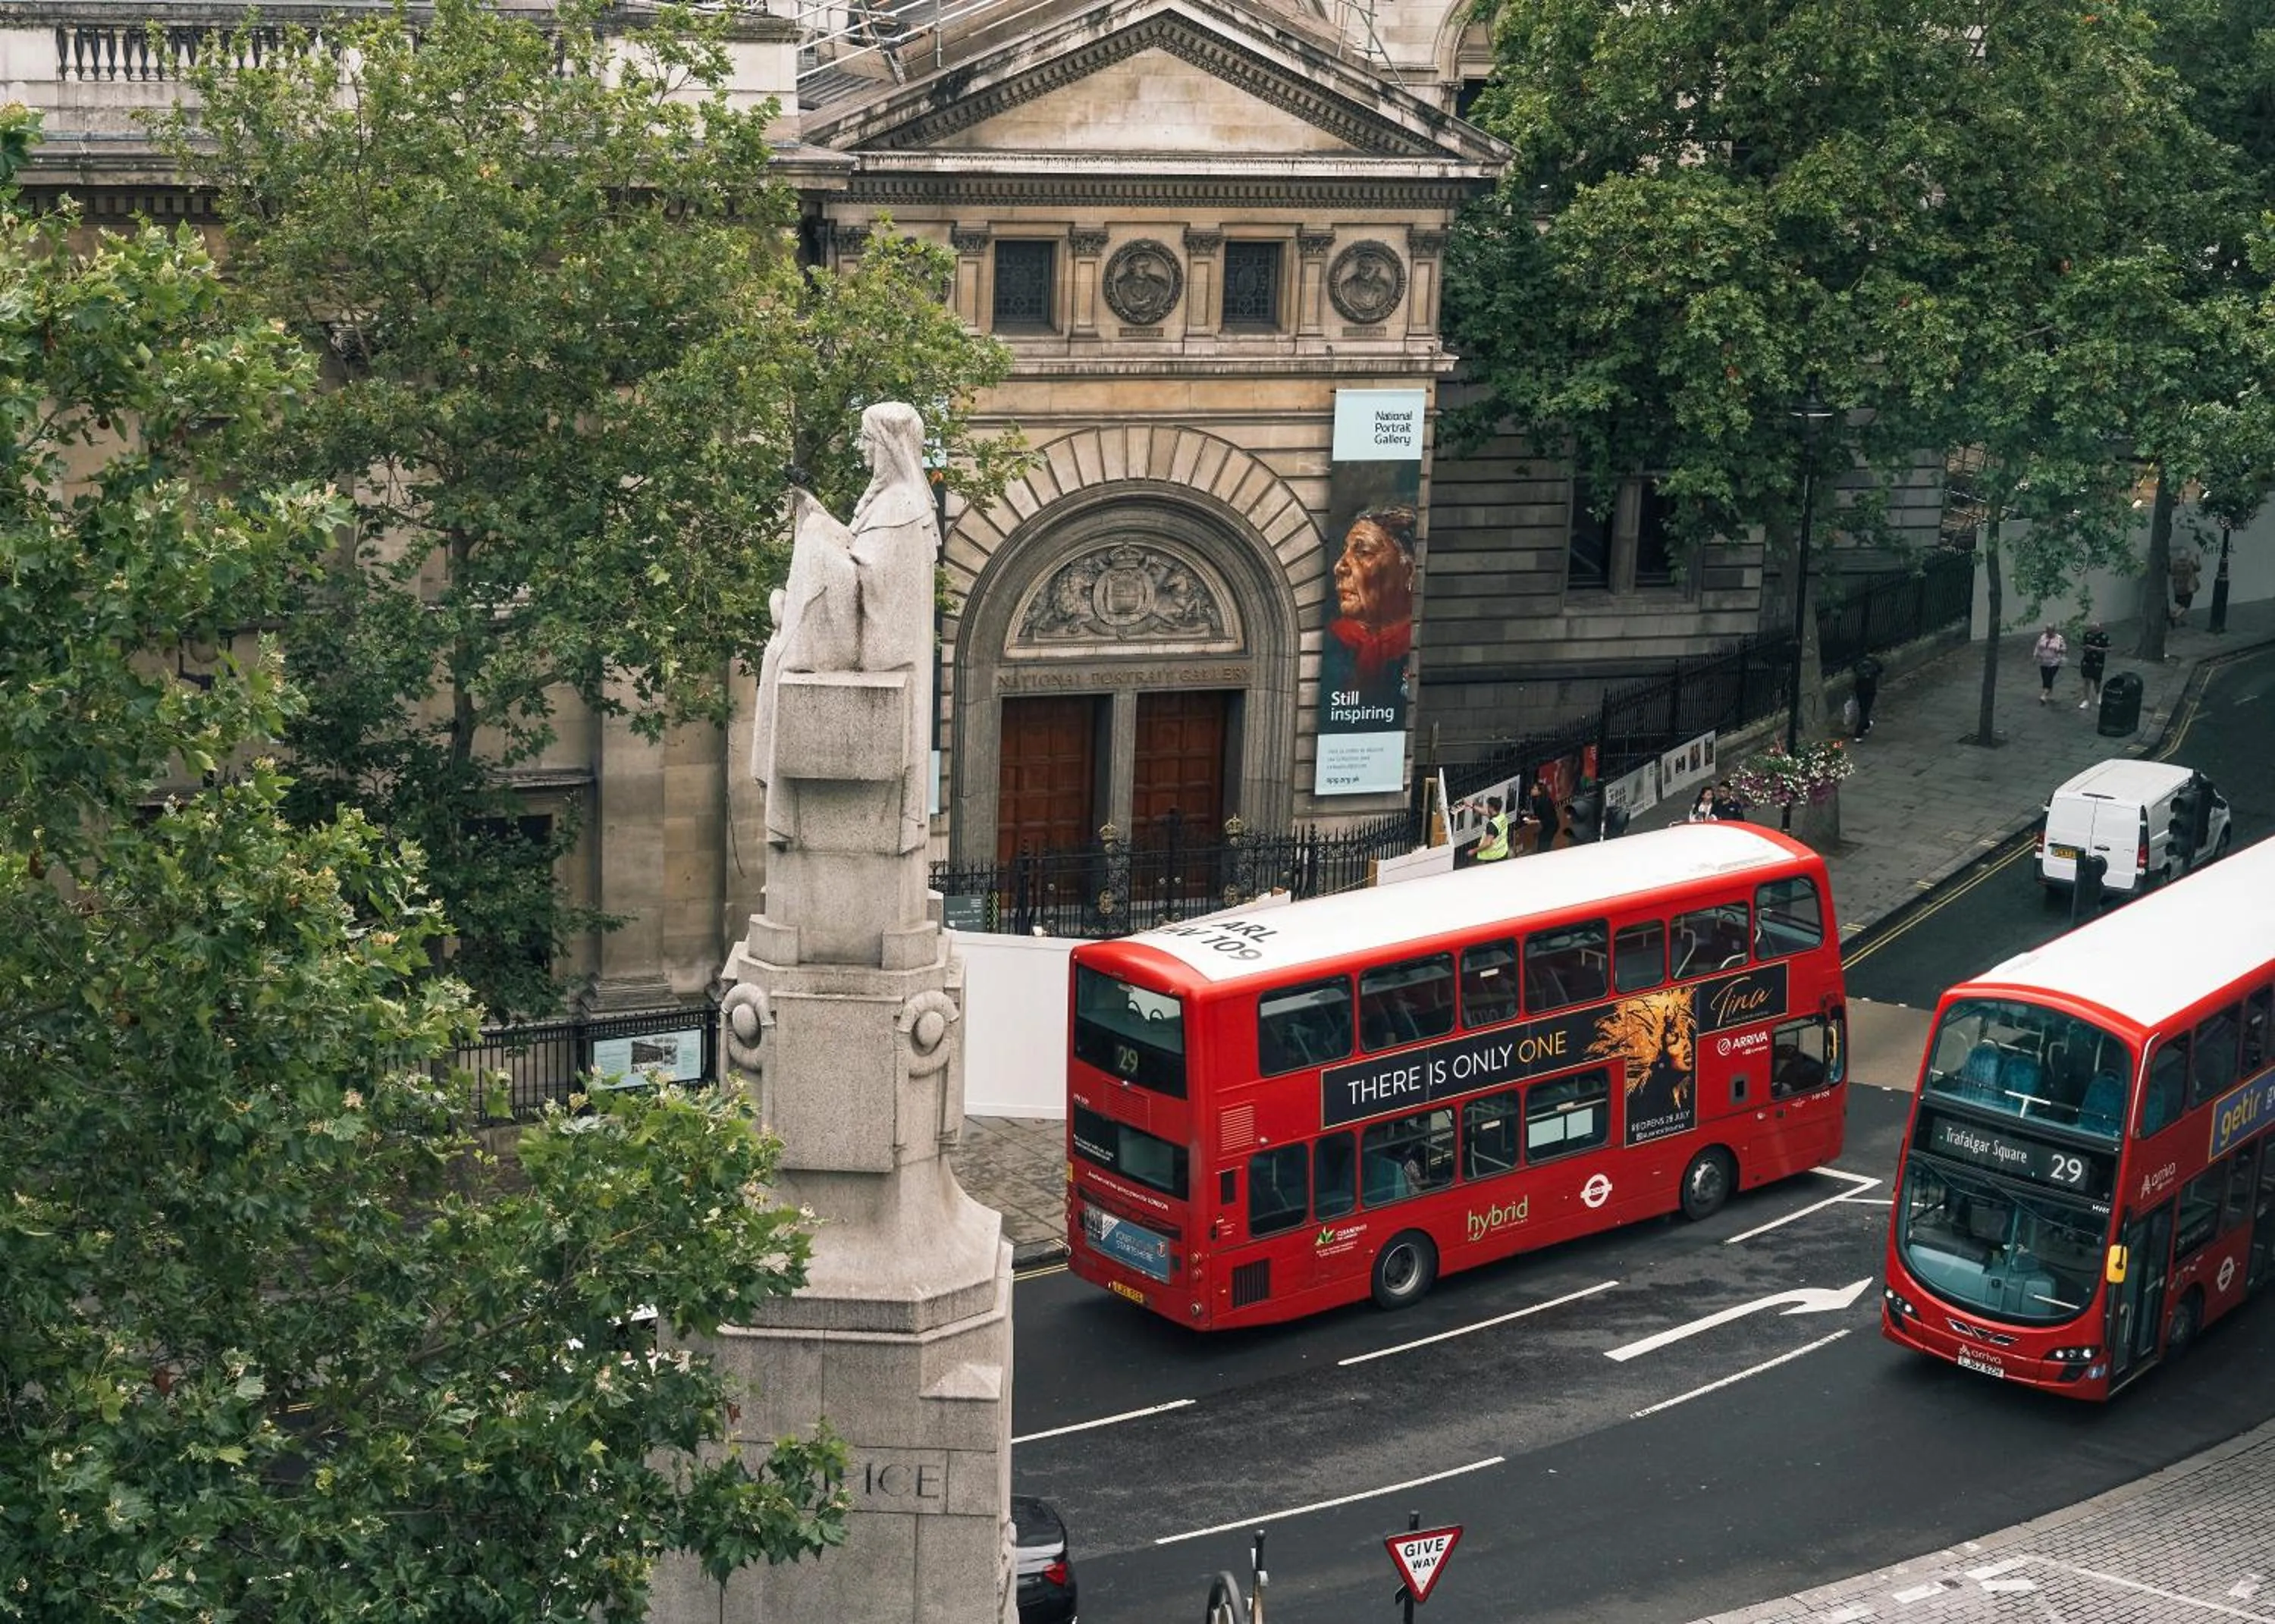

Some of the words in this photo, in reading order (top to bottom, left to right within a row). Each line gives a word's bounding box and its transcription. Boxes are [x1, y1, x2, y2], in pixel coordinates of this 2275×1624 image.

[1375, 410, 1413, 421] National
[1375, 422, 1412, 433] Portrait
[1374, 433, 1411, 447] Gallery
[997, 672, 1081, 688] NATIONAL
[1090, 669, 1172, 685] PORTRAIT
[1178, 665, 1251, 682] GALLERY
[1331, 691, 1360, 706] Still
[1331, 705, 1395, 724] inspiring
[1211, 920, 1279, 943] ARL
[1201, 935, 1263, 961] 109
[1710, 976, 1774, 1027] Tina
[1733, 1031, 1768, 1049] ARRIVA
[1118, 1046, 1138, 1073] 29
[1348, 1065, 1422, 1105] THERE
[1429, 1059, 1447, 1086] IS
[1452, 1043, 1514, 1079] ONLY
[1519, 1030, 1568, 1063] ONE
[1674, 1109, 1691, 1121] JULY
[2220, 1088, 2262, 1148] getir
[1946, 1127, 1991, 1154] Trafalgar
[1992, 1140, 2028, 1164] Square
[2050, 1153, 2084, 1184] 29
[1467, 1193, 1528, 1242] hybrid
[1971, 1350, 2002, 1364] arriva
[1404, 1538, 1445, 1557] GIVE
[1412, 1557, 1438, 1569] WAY
